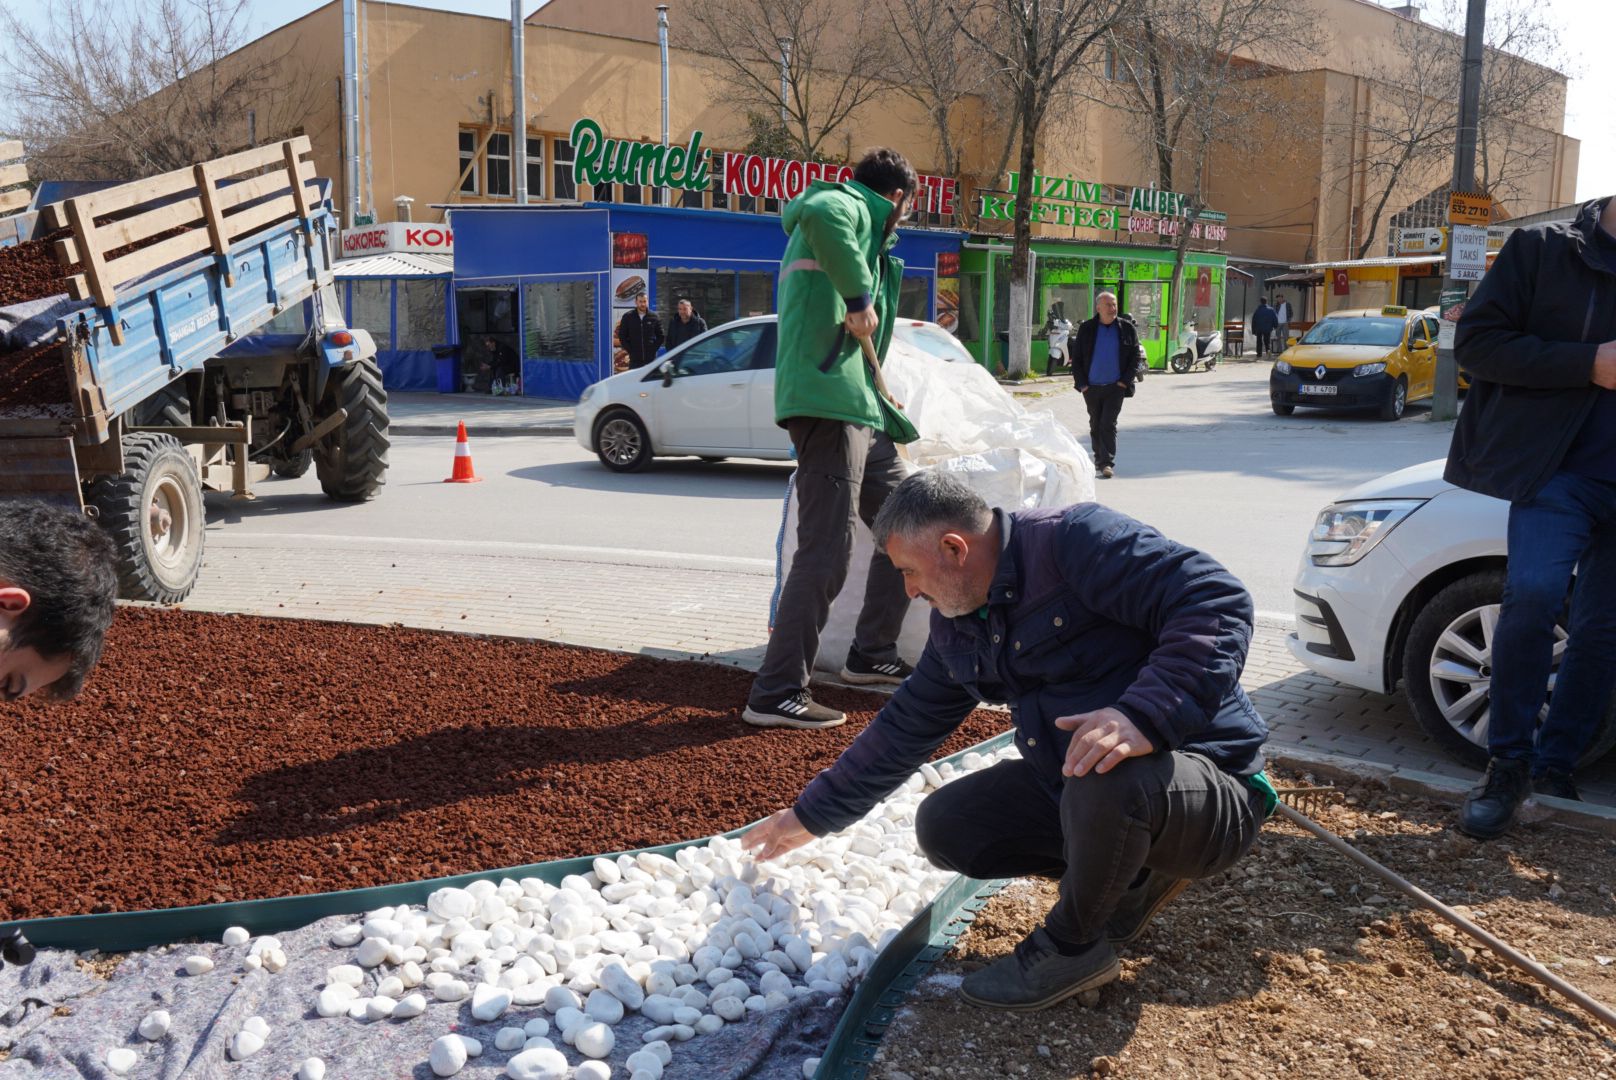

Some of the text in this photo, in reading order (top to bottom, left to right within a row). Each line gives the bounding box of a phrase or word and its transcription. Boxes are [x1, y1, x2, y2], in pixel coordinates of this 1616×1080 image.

[570, 117, 713, 192] Rumeli
[1452, 205, 1489, 216] 532 27 10
[1454, 232, 1486, 246] HÜRRİYET
[1460, 250, 1479, 261] TAKSİ
